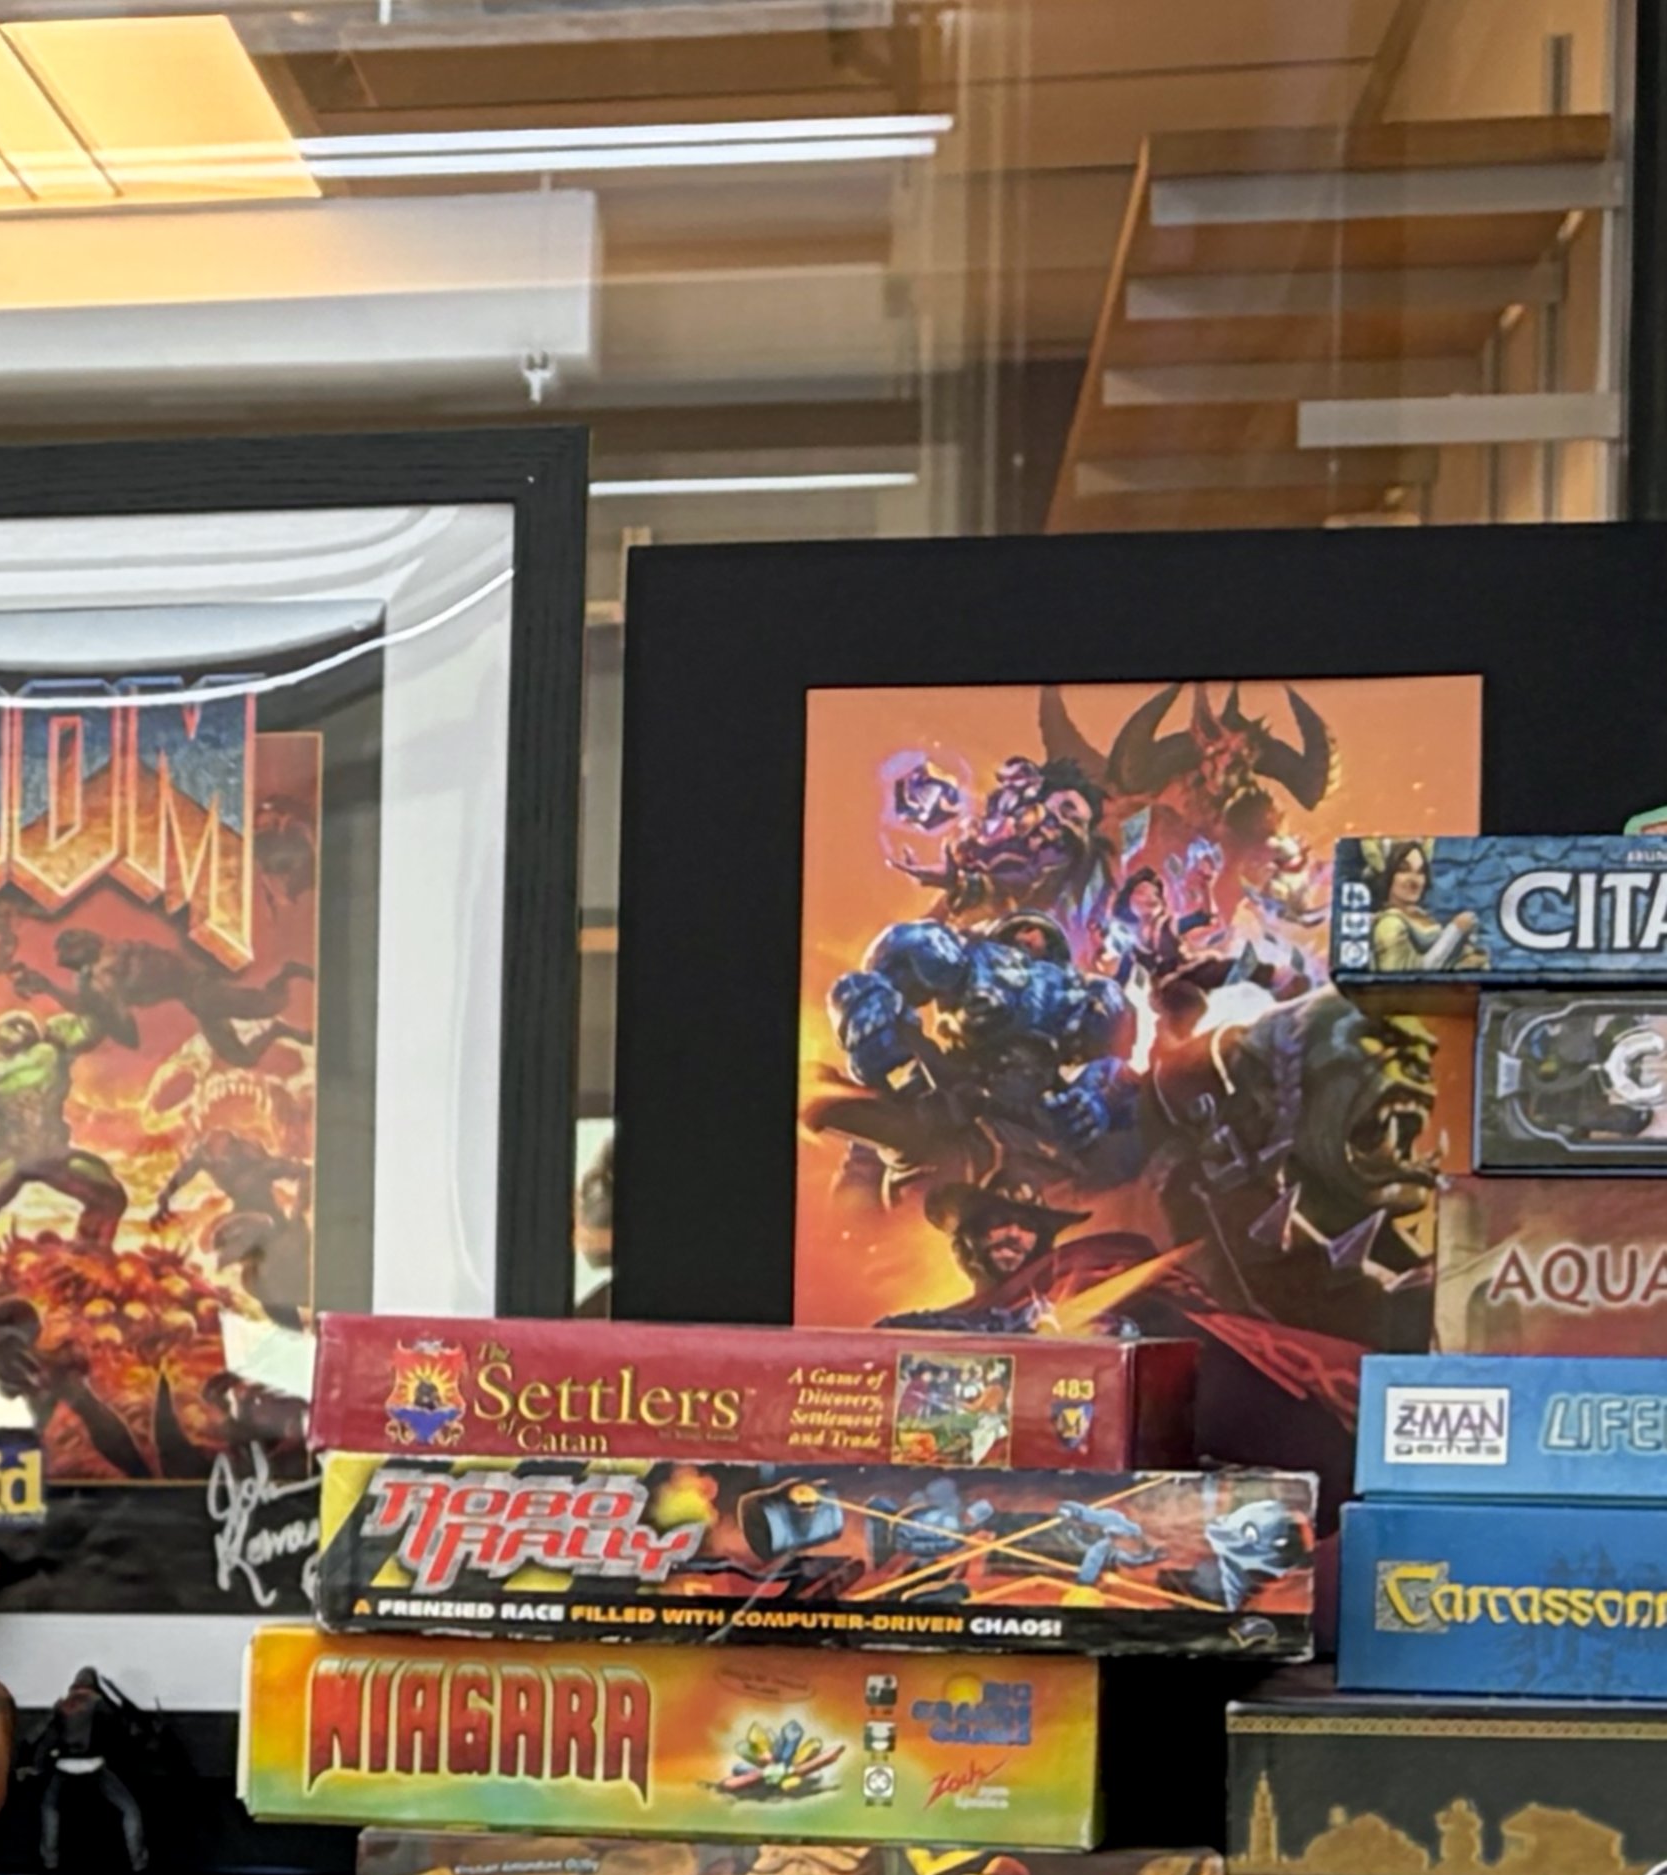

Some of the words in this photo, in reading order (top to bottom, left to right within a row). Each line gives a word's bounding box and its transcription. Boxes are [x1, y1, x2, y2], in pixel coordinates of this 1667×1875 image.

[473, 1361, 740, 1429] Settlers
[787, 1366, 804, 1385] A
[810, 1367, 863, 1386] Game
[867, 1369, 889, 1391] of
[789, 1407, 883, 1428] Settlement
[517, 1423, 608, 1454] Catan
[788, 1429, 826, 1447] and
[830, 1429, 882, 1448] Trade
[374, 1477, 637, 1570] ROBO
[425, 1521, 695, 1588] RALLY
[378, 1599, 496, 1620] FRENZIED
[501, 1602, 565, 1621] RACE
[570, 1604, 656, 1624] FILLED
[662, 1607, 725, 1627] WITH
[731, 1610, 965, 1634] COMPUTER-DRIVEN
[969, 1617, 1063, 1638] CHAOS!
[306, 1655, 651, 1803] NIAGARA
